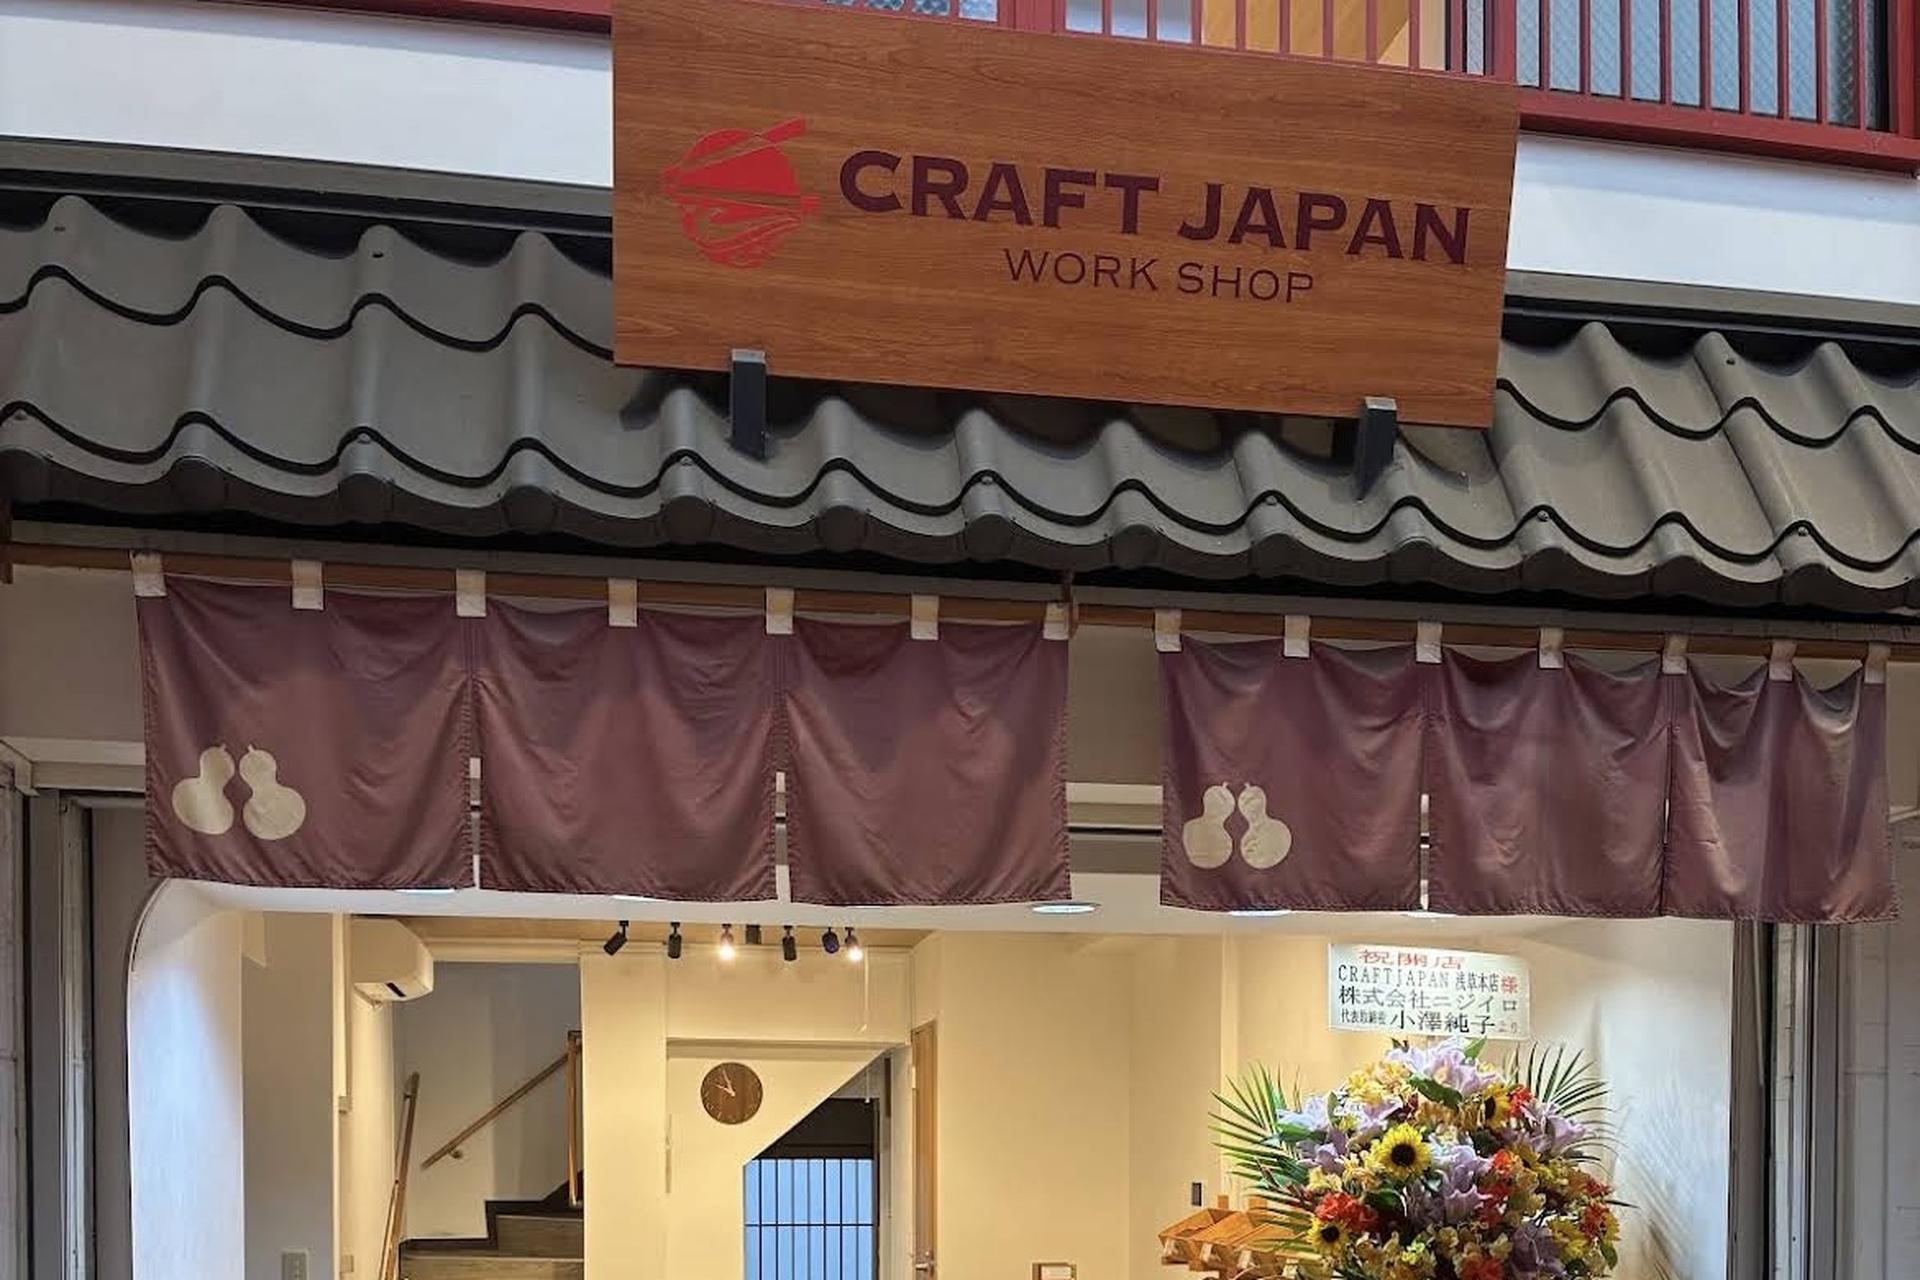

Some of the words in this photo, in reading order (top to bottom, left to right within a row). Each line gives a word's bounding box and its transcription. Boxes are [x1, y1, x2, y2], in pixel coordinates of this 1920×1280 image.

[839, 149, 1160, 235] CRAFT
[1178, 183, 1472, 265] JAPAN
[1004, 247, 1159, 292] WORK
[1176, 261, 1315, 304] SHOP
[1359, 949, 1465, 970] 祝開店
[1338, 985, 1518, 1012] 株式会社ニジイロ
